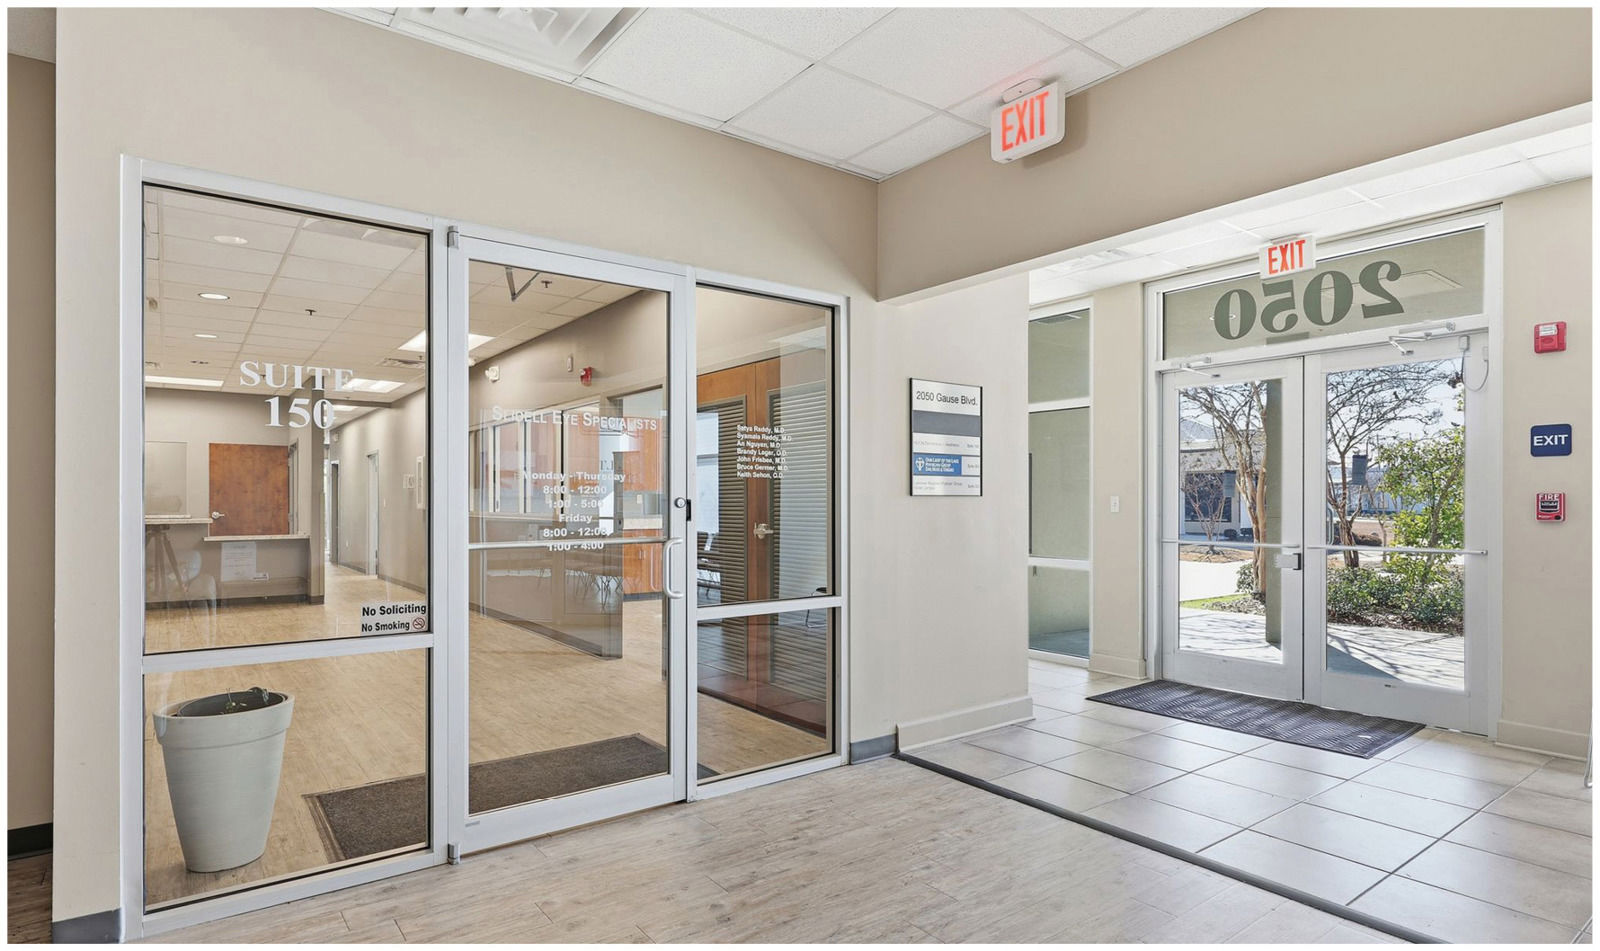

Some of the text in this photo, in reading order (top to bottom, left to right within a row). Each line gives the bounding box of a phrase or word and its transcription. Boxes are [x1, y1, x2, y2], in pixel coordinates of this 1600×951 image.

[1001, 91, 1049, 152] EXIT
[1267, 239, 1306, 275] EXIT
[239, 360, 354, 393] SUITE
[916, 391, 978, 406] 2050 Gause Blvd.
[264, 396, 335, 430] 150
[1533, 434, 1569, 447] EXIT
[523, 472, 566, 482] Monday
[576, 471, 626, 483] Thursday
[543, 485, 567, 495] 8:00
[577, 485, 607, 495] 12:00
[1539, 493, 1560, 501] FIRE
[548, 499, 570, 509] 1:00
[581, 499, 605, 508] 5:00
[559, 513, 593, 524] Friday
[543, 528, 567, 537] 8:00
[577, 527, 607, 536] 12:00
[548, 542, 571, 551] 1:00
[581, 541, 604, 551] 4:00
[362, 603, 427, 616] No Soliciting
[361, 620, 410, 632] No Smoking
